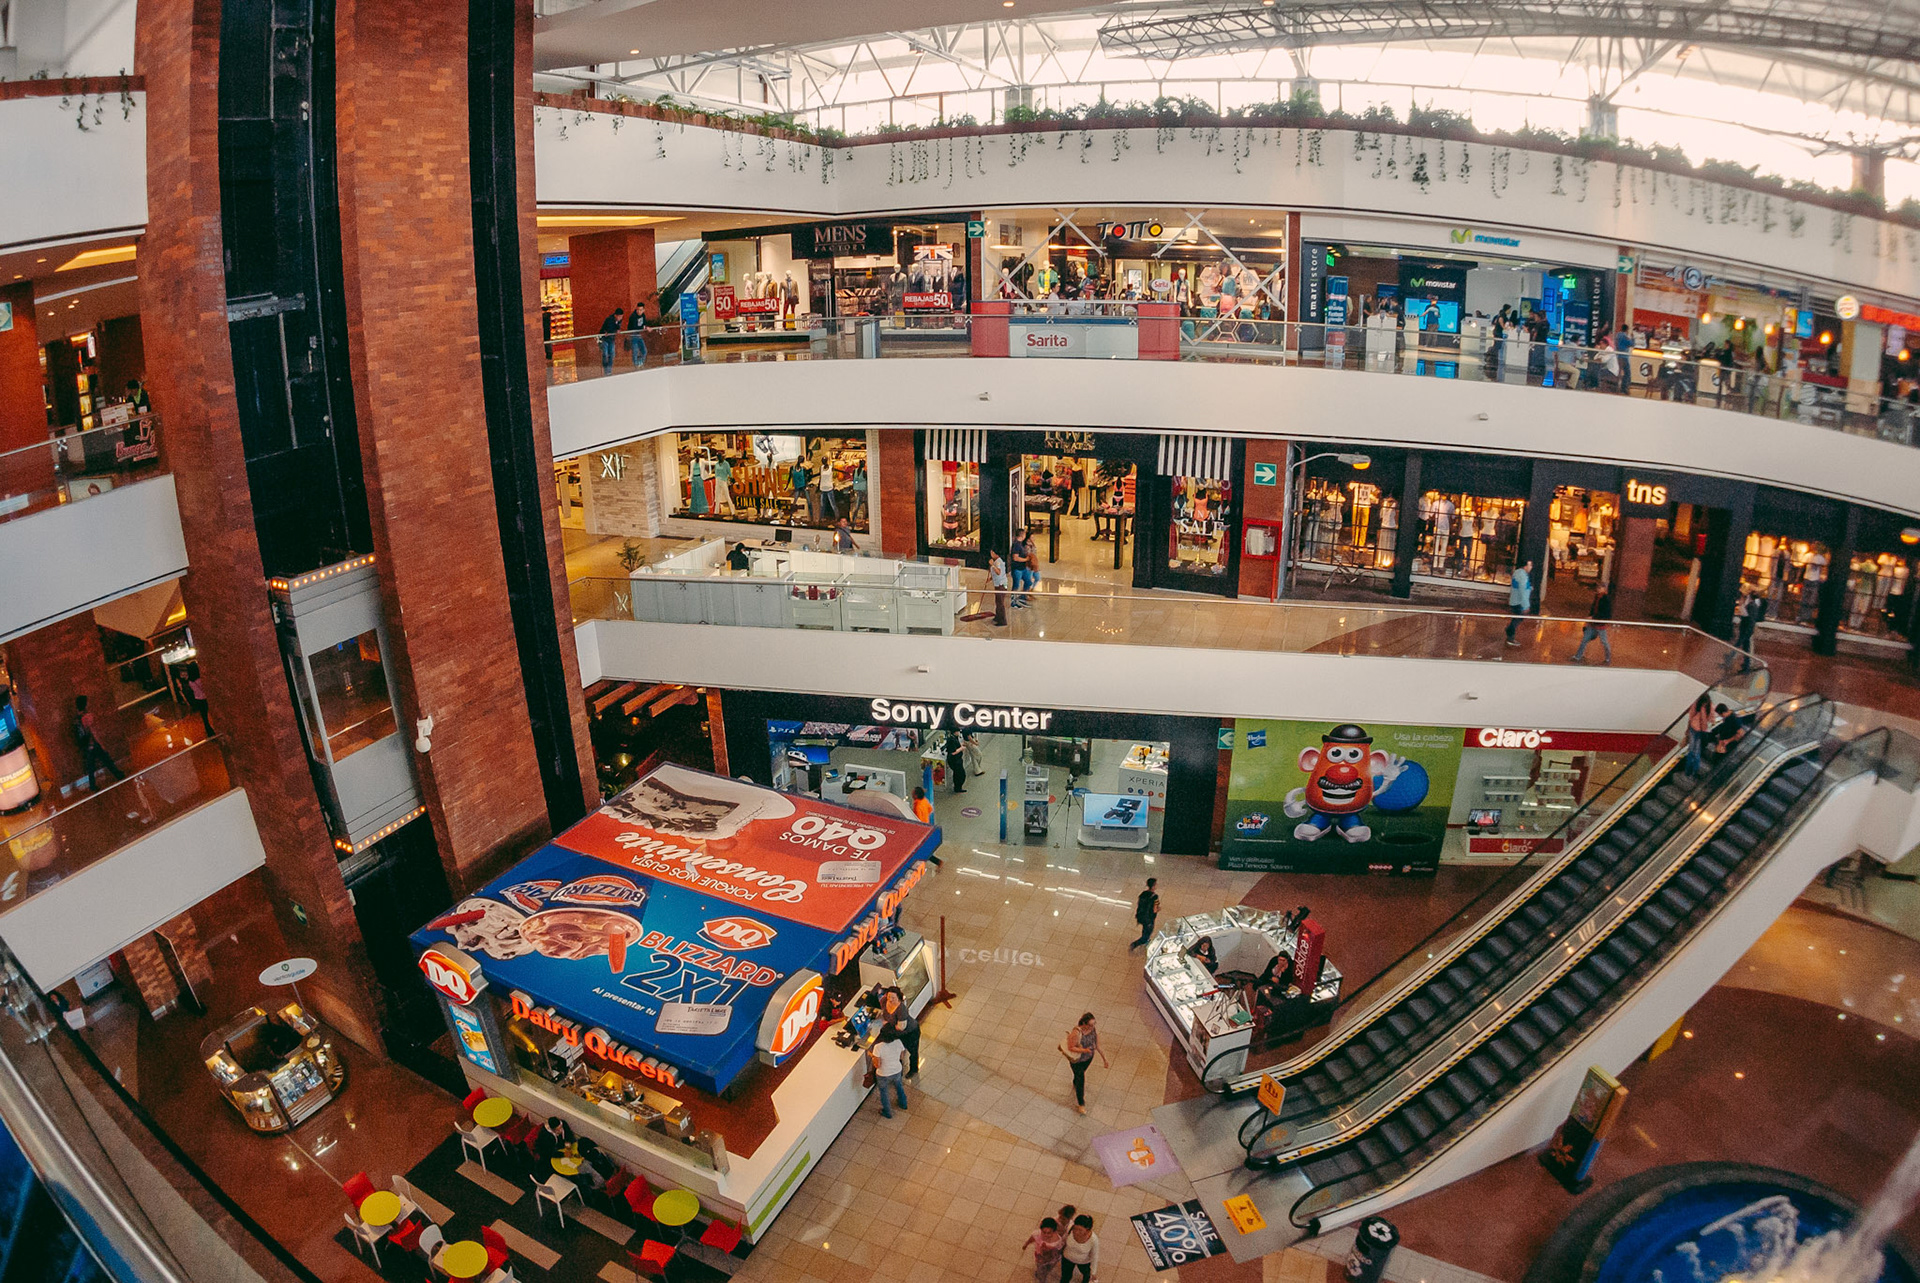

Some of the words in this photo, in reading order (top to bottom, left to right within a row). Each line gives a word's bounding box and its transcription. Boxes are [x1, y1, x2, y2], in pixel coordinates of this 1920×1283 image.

[815, 225, 867, 243] MENS
[1096, 221, 1164, 240] TOTTO
[1475, 234, 1520, 247] movistar
[814, 244, 866, 252] FACTORY
[1425, 280, 1457, 289] movistar
[716, 296, 731, 312] 50
[741, 300, 765, 308] REBAJAS
[765, 298, 777, 310] 50
[905, 295, 934, 303] REBAJAS
[933, 293, 948, 306] 50
[1027, 333, 1068, 347] Sarita
[733, 466, 794, 499] SHINE
[1627, 478, 1667, 506] tns
[736, 496, 757, 508] FINAL
[760, 498, 779, 510] SALE
[1180, 508, 1225, 521] FINAL
[1180, 518, 1224, 537] SALE
[872, 698, 945, 729] Sony
[953, 703, 1052, 730] Center
[1478, 727, 1541, 748] Claro
[1129, 776, 1165, 787] XPERIA
[779, 831, 848, 855] DAMOS
[791, 816, 887, 850] Q40
[850, 849, 871, 861] TE
[1501, 840, 1528, 853] Claro
[614, 832, 808, 903] Consentirte
[631, 854, 670, 873] GUSTA
[668, 866, 701, 883] NOS
[699, 876, 758, 900] PORQUE
[836, 913, 879, 976] Dairy
[881, 861, 927, 919] Queen
[711, 921, 763, 947] DQ
[1294, 939, 1309, 979] solstice
[425, 958, 468, 1002] DQ
[592, 986, 602, 994] Al
[602, 991, 645, 1011] presentar
[645, 1007, 657, 1016] tu
[782, 991, 818, 1051] DQ
[509, 996, 579, 1048] Dairy
[584, 1031, 677, 1088] Queen
[1190, 1211, 1218, 1242] SALE
[1132, 1220, 1165, 1267] SPORTLINE
[1154, 1212, 1201, 1263] 40%
